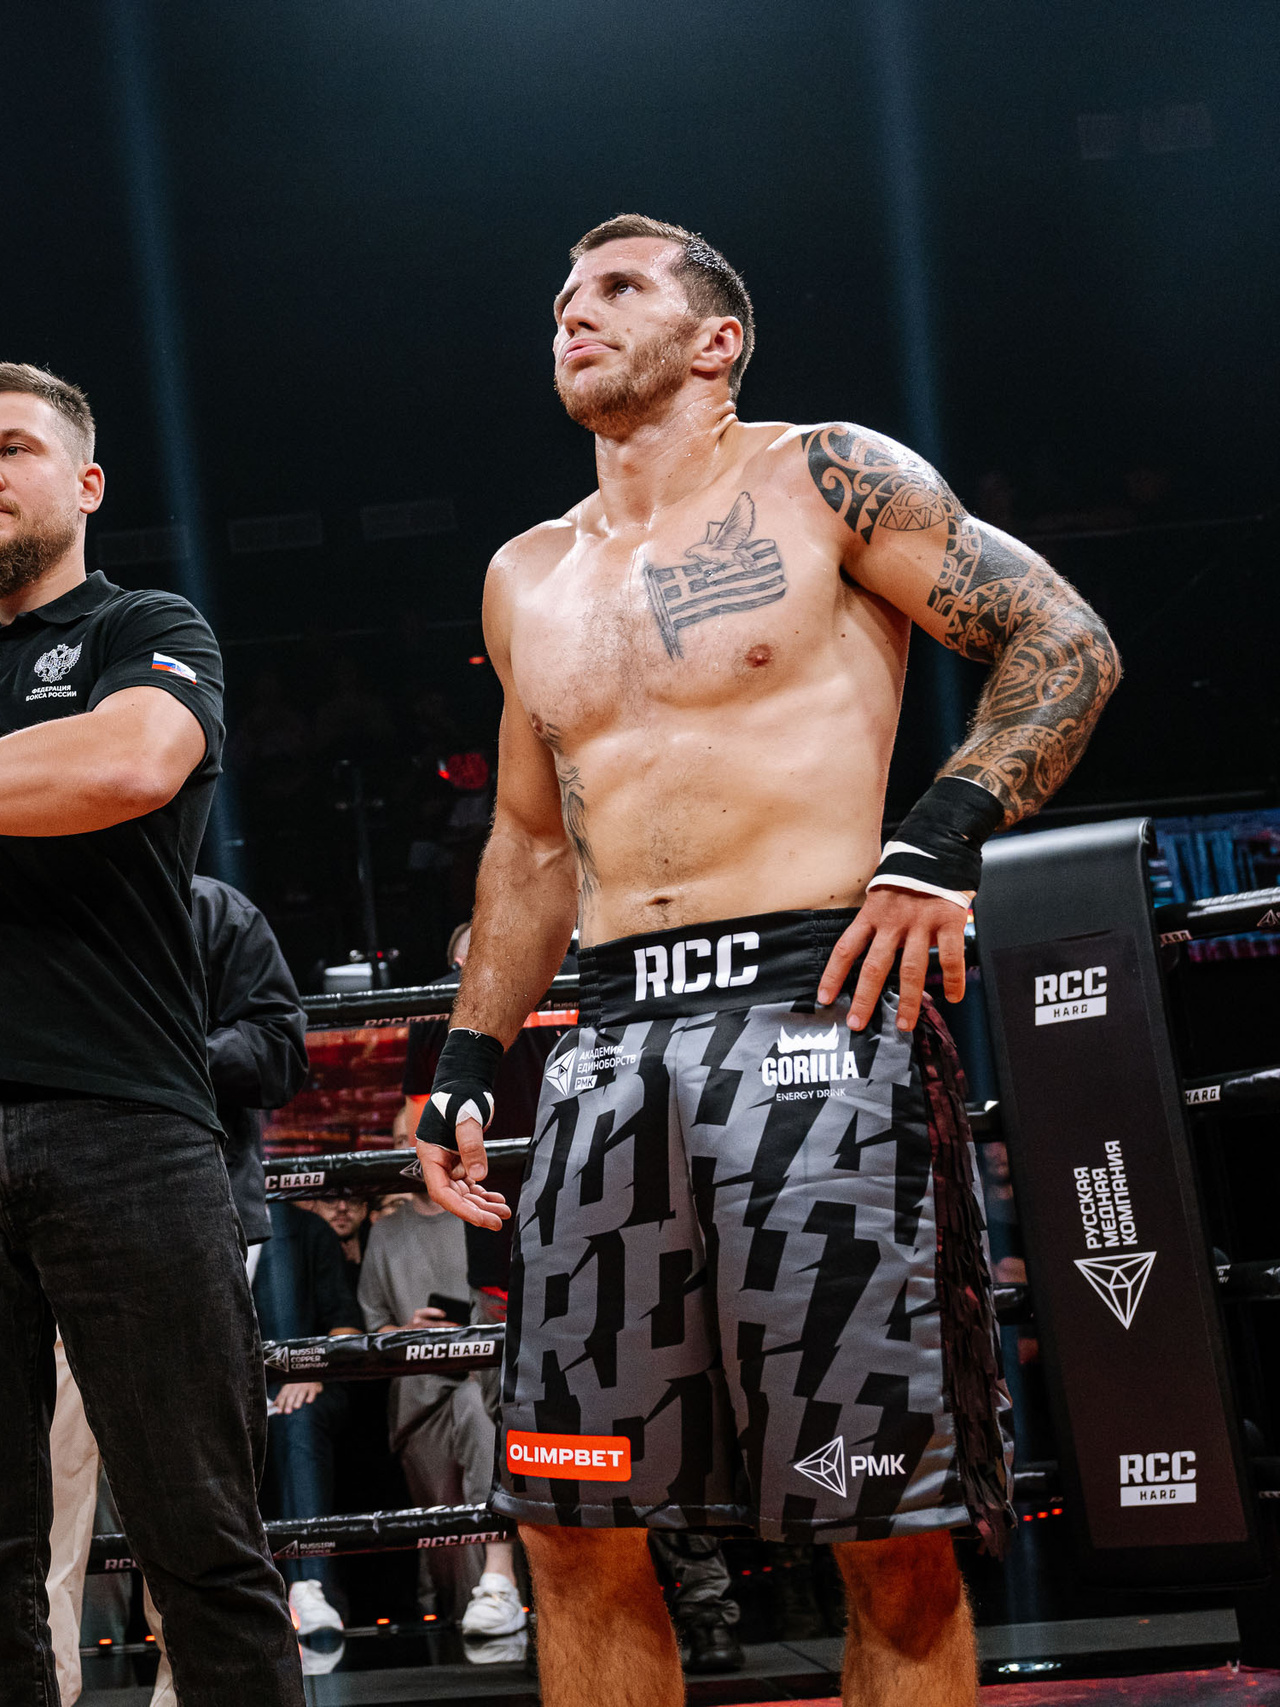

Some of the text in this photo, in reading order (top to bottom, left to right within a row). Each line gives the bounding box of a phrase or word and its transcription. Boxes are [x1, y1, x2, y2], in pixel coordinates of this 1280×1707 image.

[26, 691, 77, 701] БОКСА РОССИИ
[32, 685, 71, 694] ФЕДЕРАЦИЯ
[634, 932, 760, 1002] RCC
[1035, 966, 1107, 1004] RCC
[1052, 1003, 1090, 1019] HARD
[579, 1045, 624, 1062] АКАДЕМИЯ
[577, 1054, 636, 1074] ЕДИНОБОРСТВ
[761, 1051, 859, 1087] GORILLA
[776, 1088, 846, 1102] ENERGY DRINK
[1104, 1140, 1138, 1247] КОМПАНИЯ
[1073, 1166, 1102, 1250] РУССКАЯ
[1091, 1167, 1120, 1248] МЕДНАЯ
[290, 1347, 326, 1355] RUSSIAN
[291, 1355, 321, 1363] COPPER
[406, 1343, 448, 1361] RCC
[509, 1444, 624, 1468] OLIMPBET
[1120, 1450, 1197, 1484] RCC
[1138, 1489, 1178, 1501] HARD
[105, 1558, 137, 1570] RC
